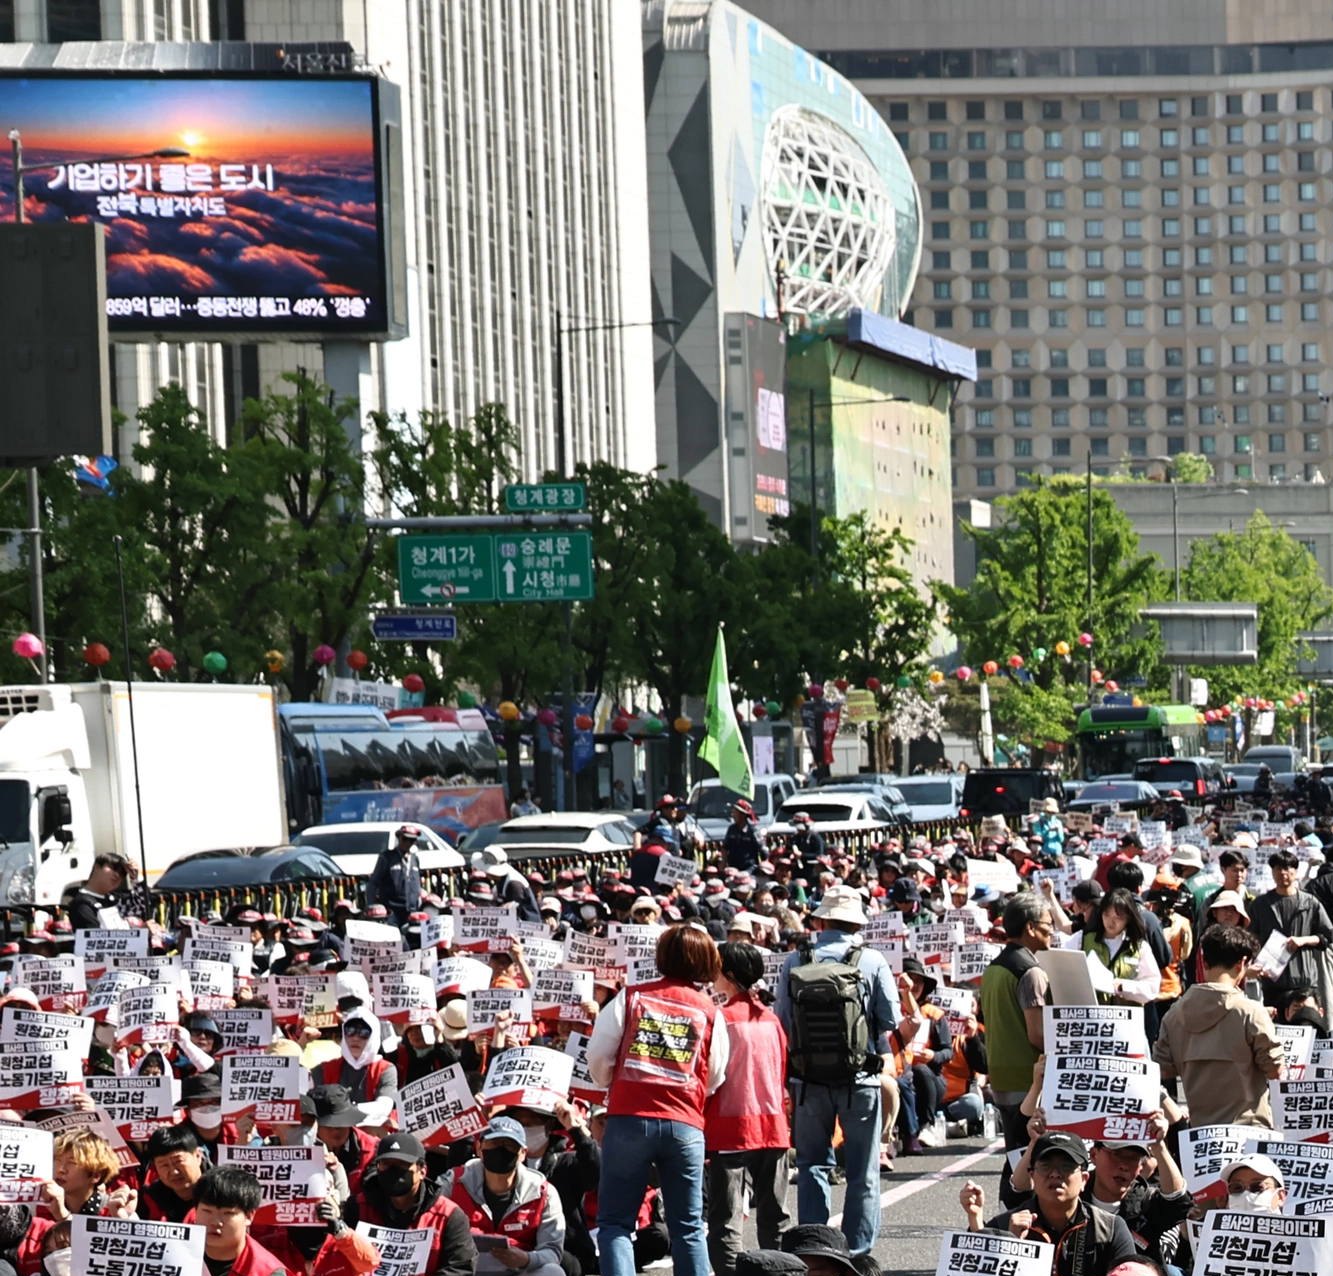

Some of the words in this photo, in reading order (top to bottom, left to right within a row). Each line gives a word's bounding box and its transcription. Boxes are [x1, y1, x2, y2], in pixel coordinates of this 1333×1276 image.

[48, 164, 152, 192] 기업하기
[159, 164, 214, 192] 좋은
[219, 164, 275, 192] 도시
[97, 192, 227, 218] 전북특별자치도
[105, 297, 147, 317] 859억
[513, 488, 577, 507] 청계광장
[411, 545, 476, 566] 청계1가
[520, 537, 572, 556] 숭례문
[411, 566, 456, 581] Cheonggye
[522, 572, 556, 589] 시청
[664, 858, 695, 872] 2026년
